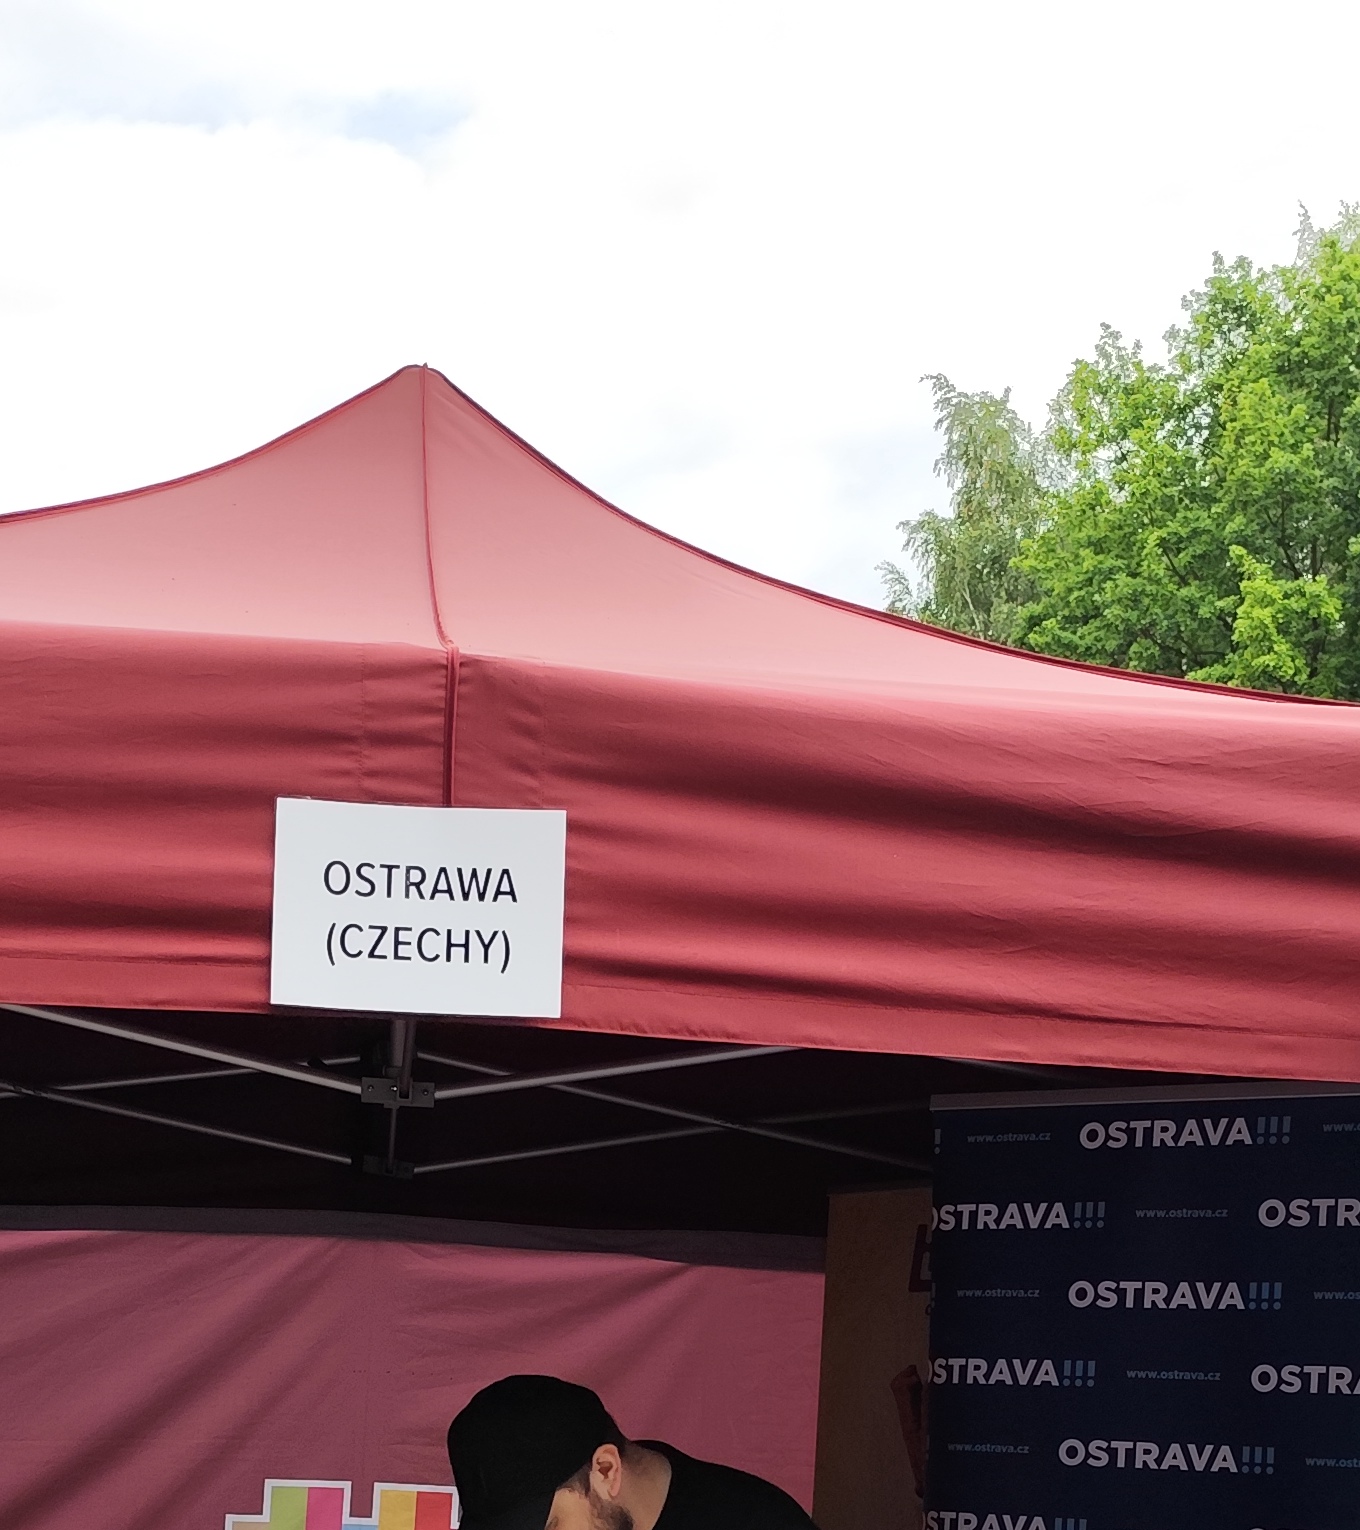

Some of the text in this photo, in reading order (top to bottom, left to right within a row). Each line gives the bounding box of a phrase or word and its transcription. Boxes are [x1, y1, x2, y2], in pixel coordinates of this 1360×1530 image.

[323, 860, 518, 904] OSTRAWA
[326, 922, 511, 975] (CZECHY)
[931, 1201, 1106, 1231] STRAVA!!!
[926, 1358, 1096, 1388] STRAVA!!!
